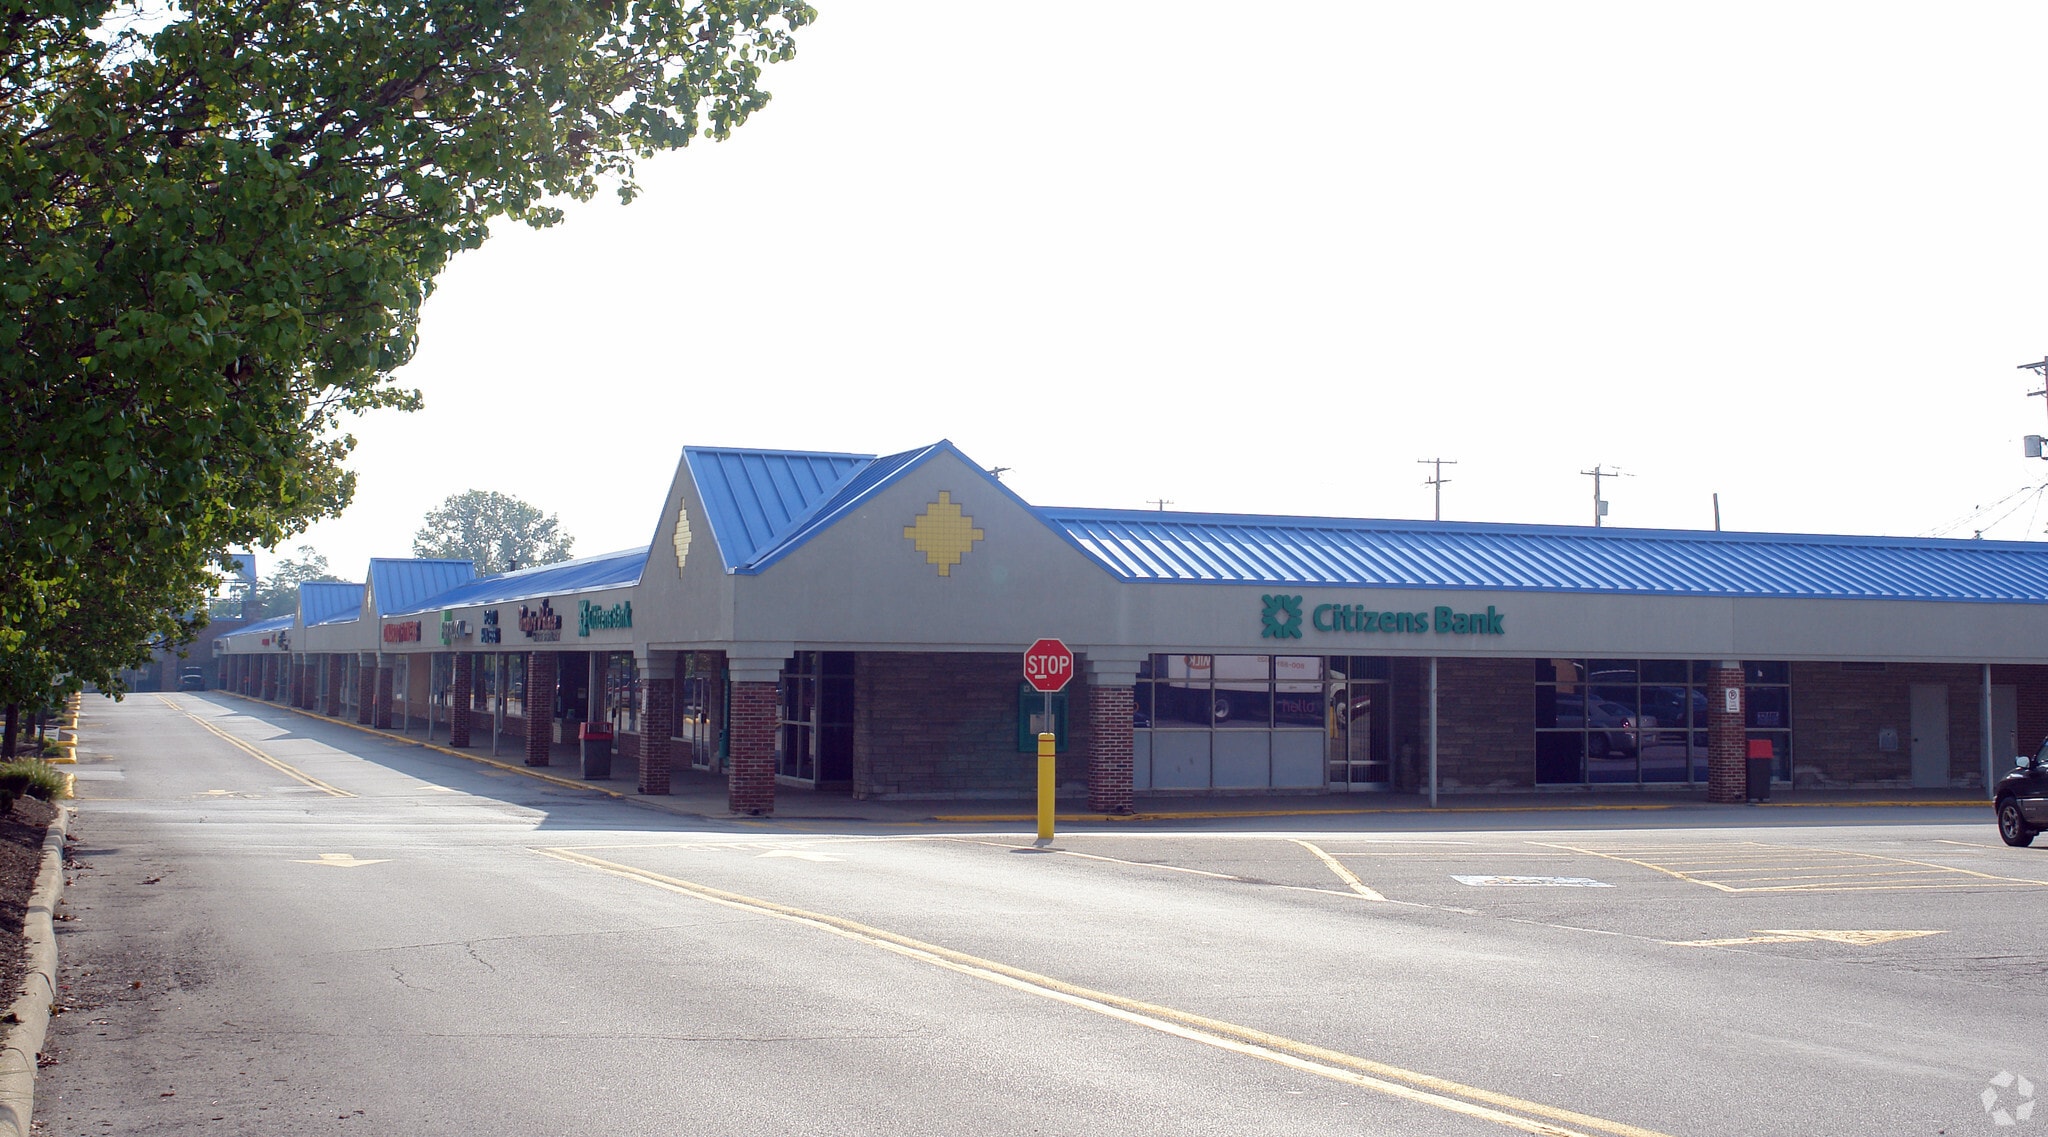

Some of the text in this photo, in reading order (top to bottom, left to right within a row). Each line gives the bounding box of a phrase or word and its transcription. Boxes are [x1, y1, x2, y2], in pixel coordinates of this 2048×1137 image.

[1313, 604, 1505, 635] Citizens Bank
[1027, 655, 1070, 675] STOP
